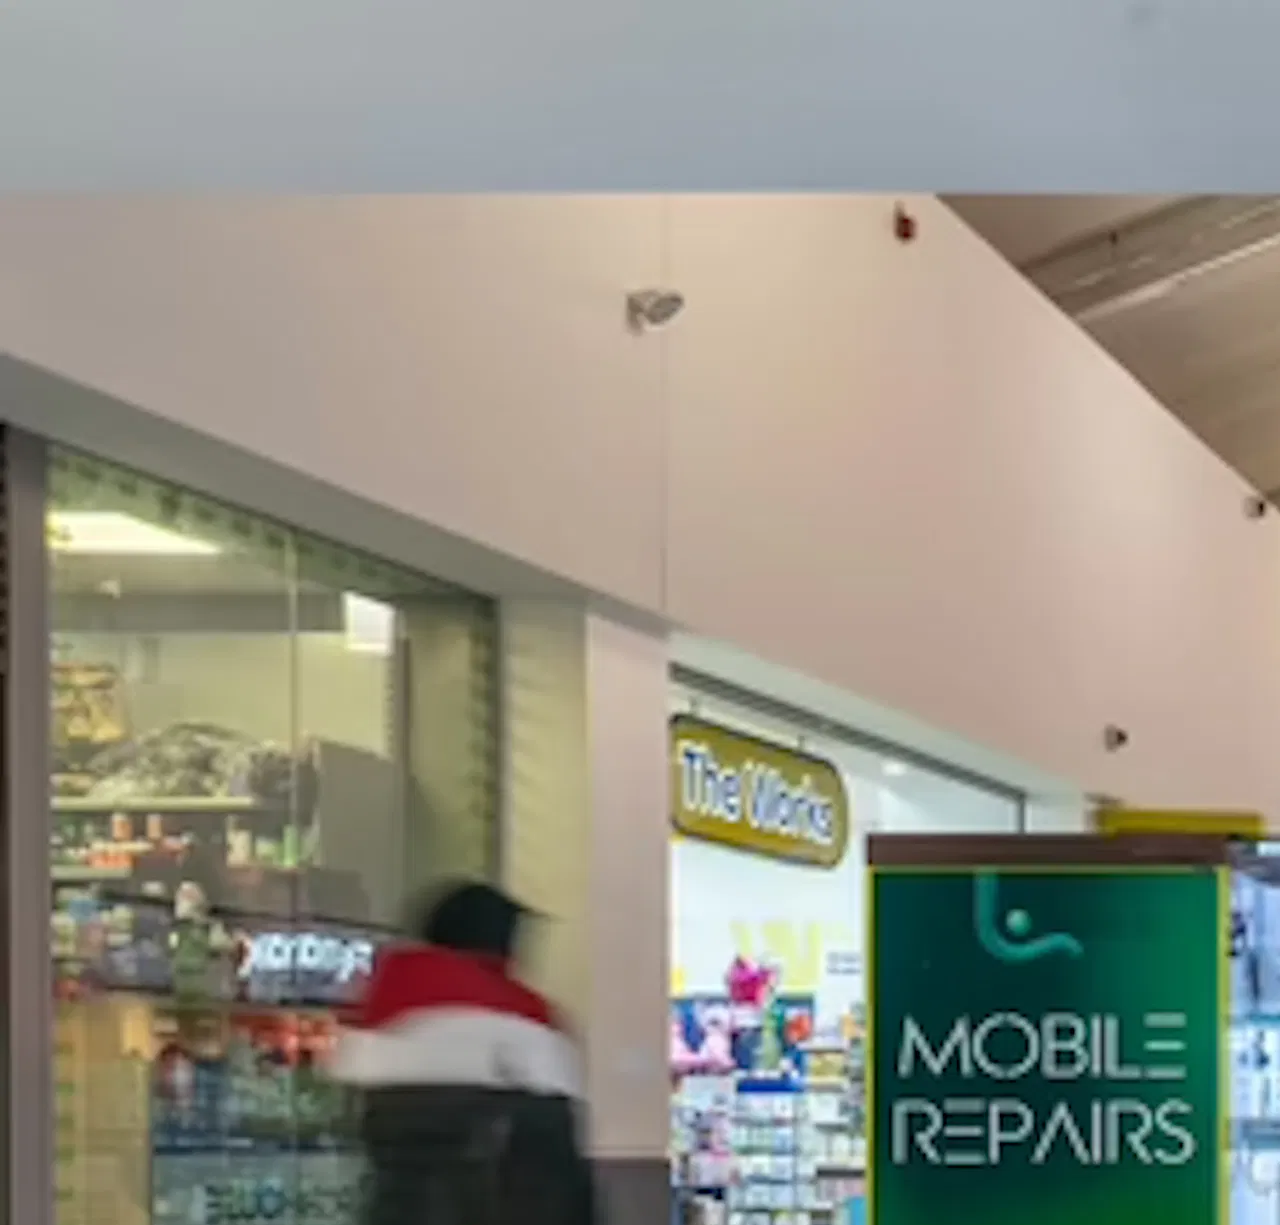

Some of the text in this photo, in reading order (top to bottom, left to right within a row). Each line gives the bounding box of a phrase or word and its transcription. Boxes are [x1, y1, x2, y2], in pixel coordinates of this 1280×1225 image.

[677, 739, 742, 824] The
[897, 1011, 1187, 1081] MOBILE
[891, 1097, 1198, 1166] REPAIRS
